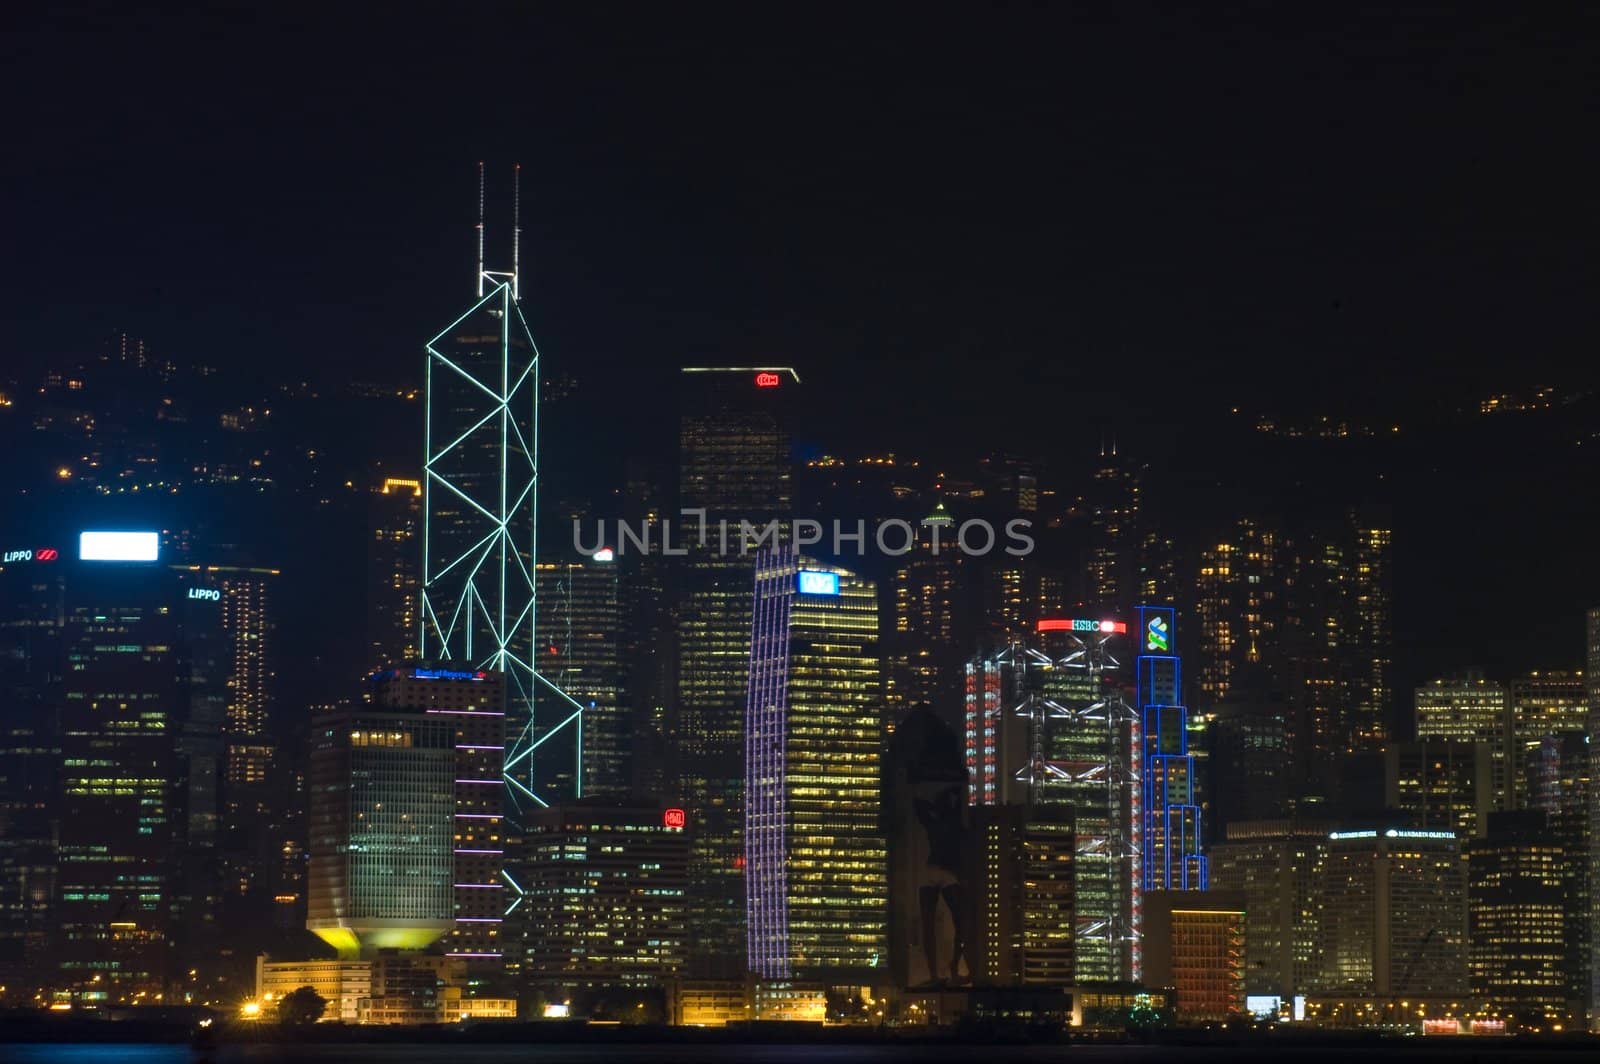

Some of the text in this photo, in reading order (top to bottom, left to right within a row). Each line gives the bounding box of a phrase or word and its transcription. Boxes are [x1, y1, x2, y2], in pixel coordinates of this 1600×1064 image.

[4, 550, 32, 562] LIPPO
[189, 588, 220, 600] LIPPO
[1072, 619, 1100, 631] HSBC
